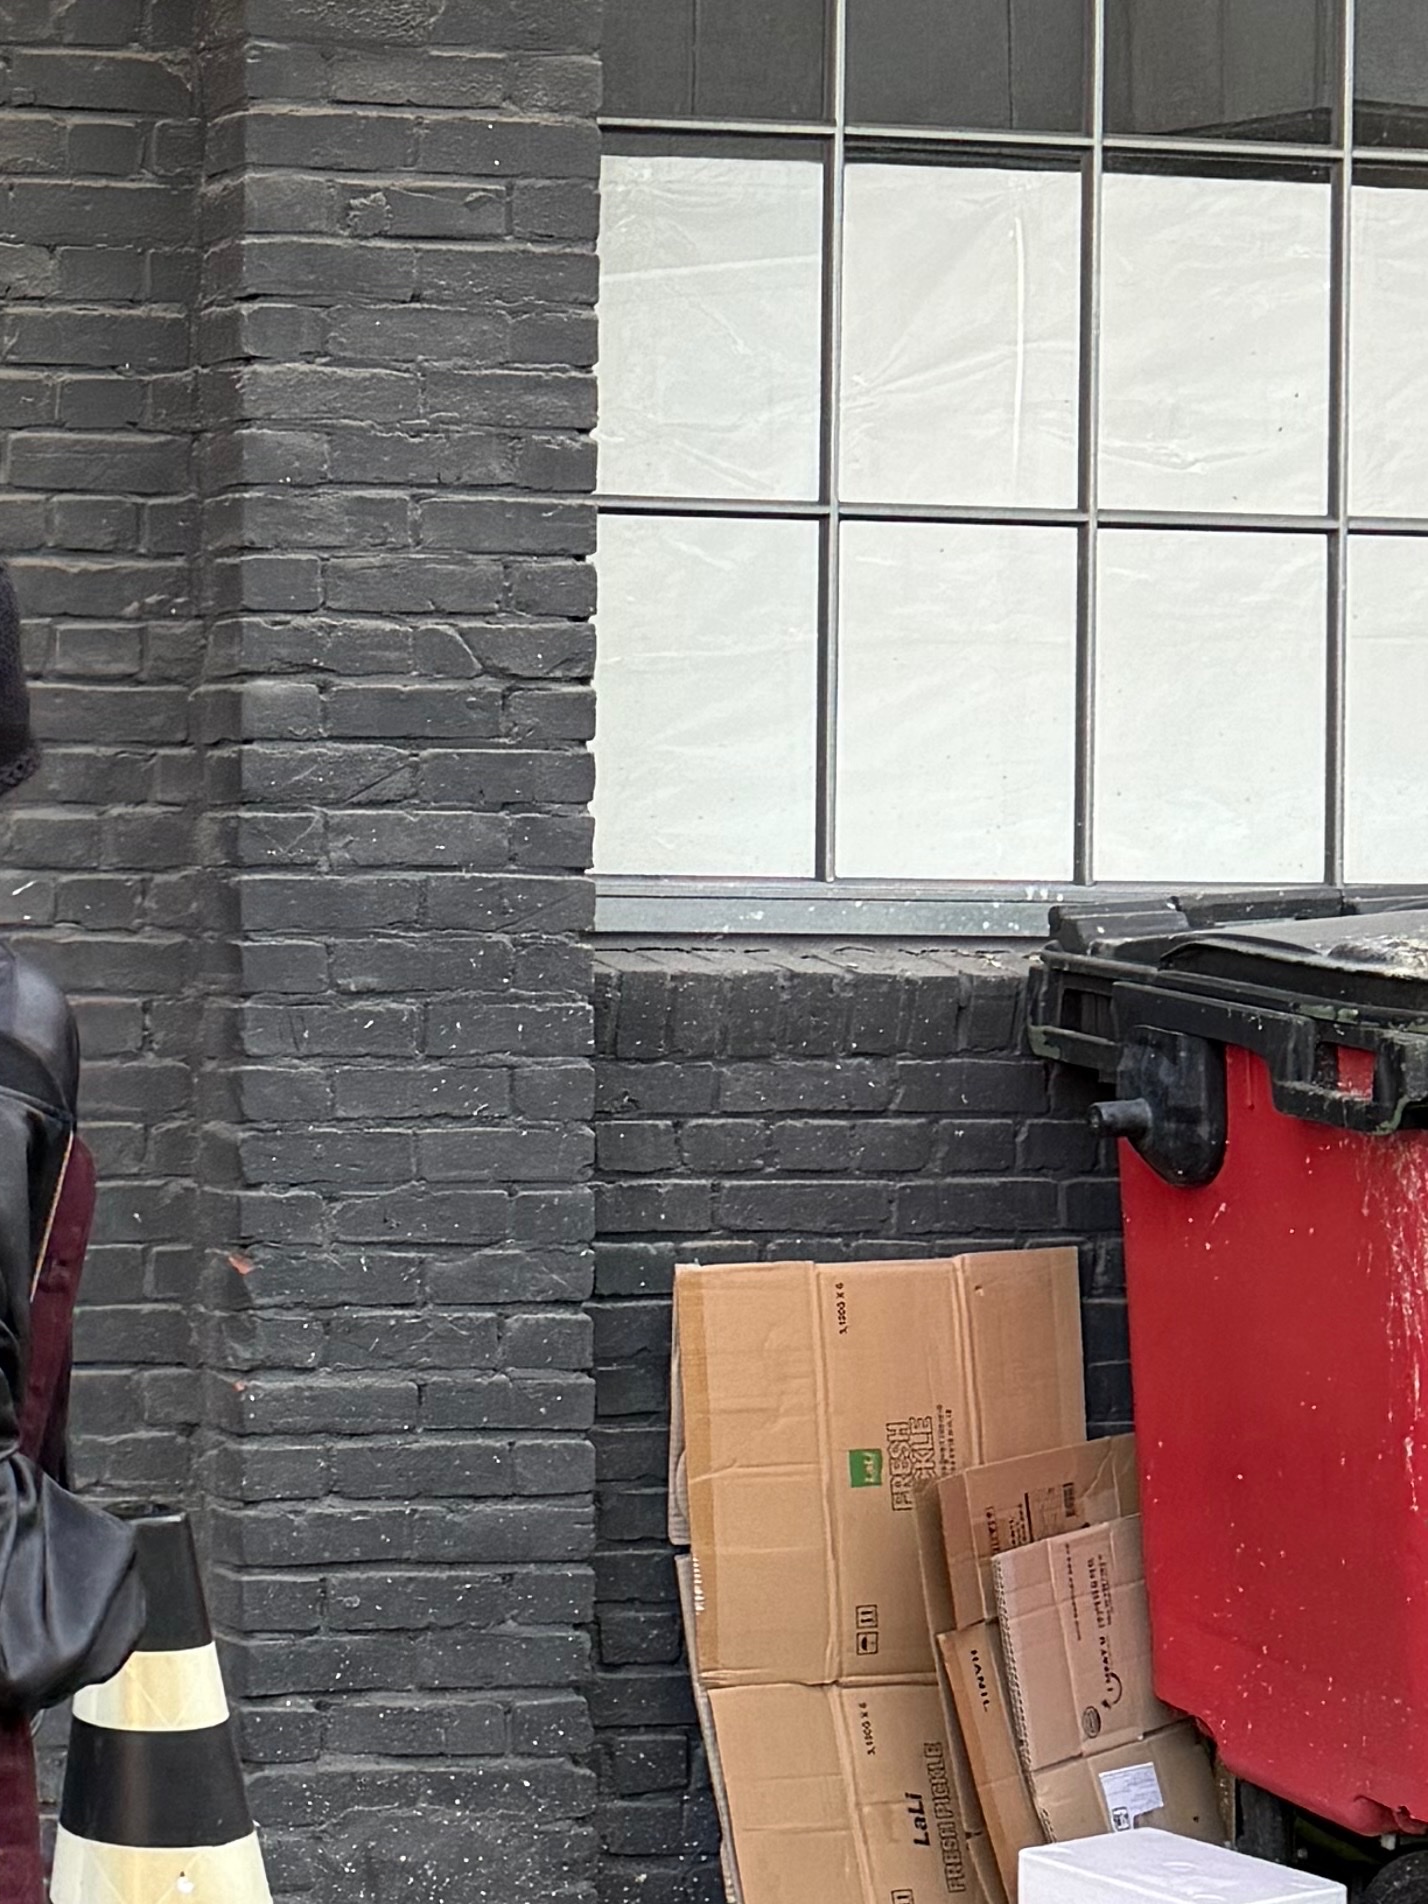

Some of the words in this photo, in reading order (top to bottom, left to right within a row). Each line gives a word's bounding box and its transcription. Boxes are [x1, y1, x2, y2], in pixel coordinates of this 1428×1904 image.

[885, 1421, 914, 1511] FRESH
[909, 1415, 937, 1480] CKLE
[924, 1741, 954, 1821] PICKLE
[904, 1792, 931, 1846] LaLi
[937, 1822, 966, 1893] FRESH
